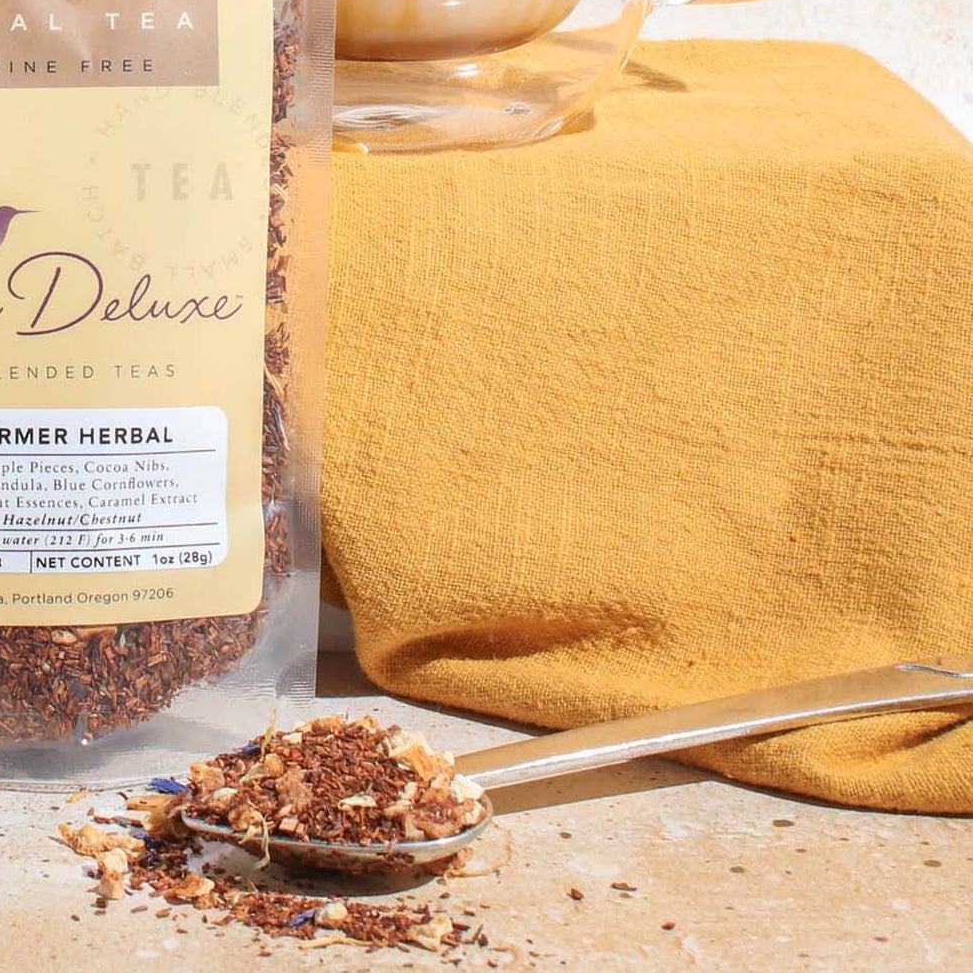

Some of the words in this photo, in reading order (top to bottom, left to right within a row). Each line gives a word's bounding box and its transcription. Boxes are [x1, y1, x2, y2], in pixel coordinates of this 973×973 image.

[106, 12, 194, 30] TEA
[81, 59, 153, 73] FREE
[131, 162, 233, 201] TEA
[114, 364, 176, 379] TEAS
[80, 426, 173, 445] HERBAL
[30, 461, 79, 475] Pieces,
[84, 460, 128, 473] Cocoa
[53, 478, 86, 491] Blue
[91, 476, 179, 491] Cornflowers,
[16, 496, 83, 509] Essences,
[88, 494, 145, 507] Caramel
[151, 493, 198, 506] Extract
[3, 512, 142, 526] Hazelnut/Chestnut
[2, 535, 39, 546] water
[44, 533, 72, 546] (212
[78, 533, 91, 546] F)
[93, 532, 114, 548] for
[118, 533, 136, 544] 3-6
[140, 531, 164, 543] min
[36, 557, 65, 569] NET
[70, 554, 141, 569] CONTENT
[152, 553, 175, 565] 1oz
[179, 550, 213, 566] (28g)
[12, 592, 72, 605] Portland
[77, 592, 128, 607] Oregon
[133, 588, 174, 601] 97206
